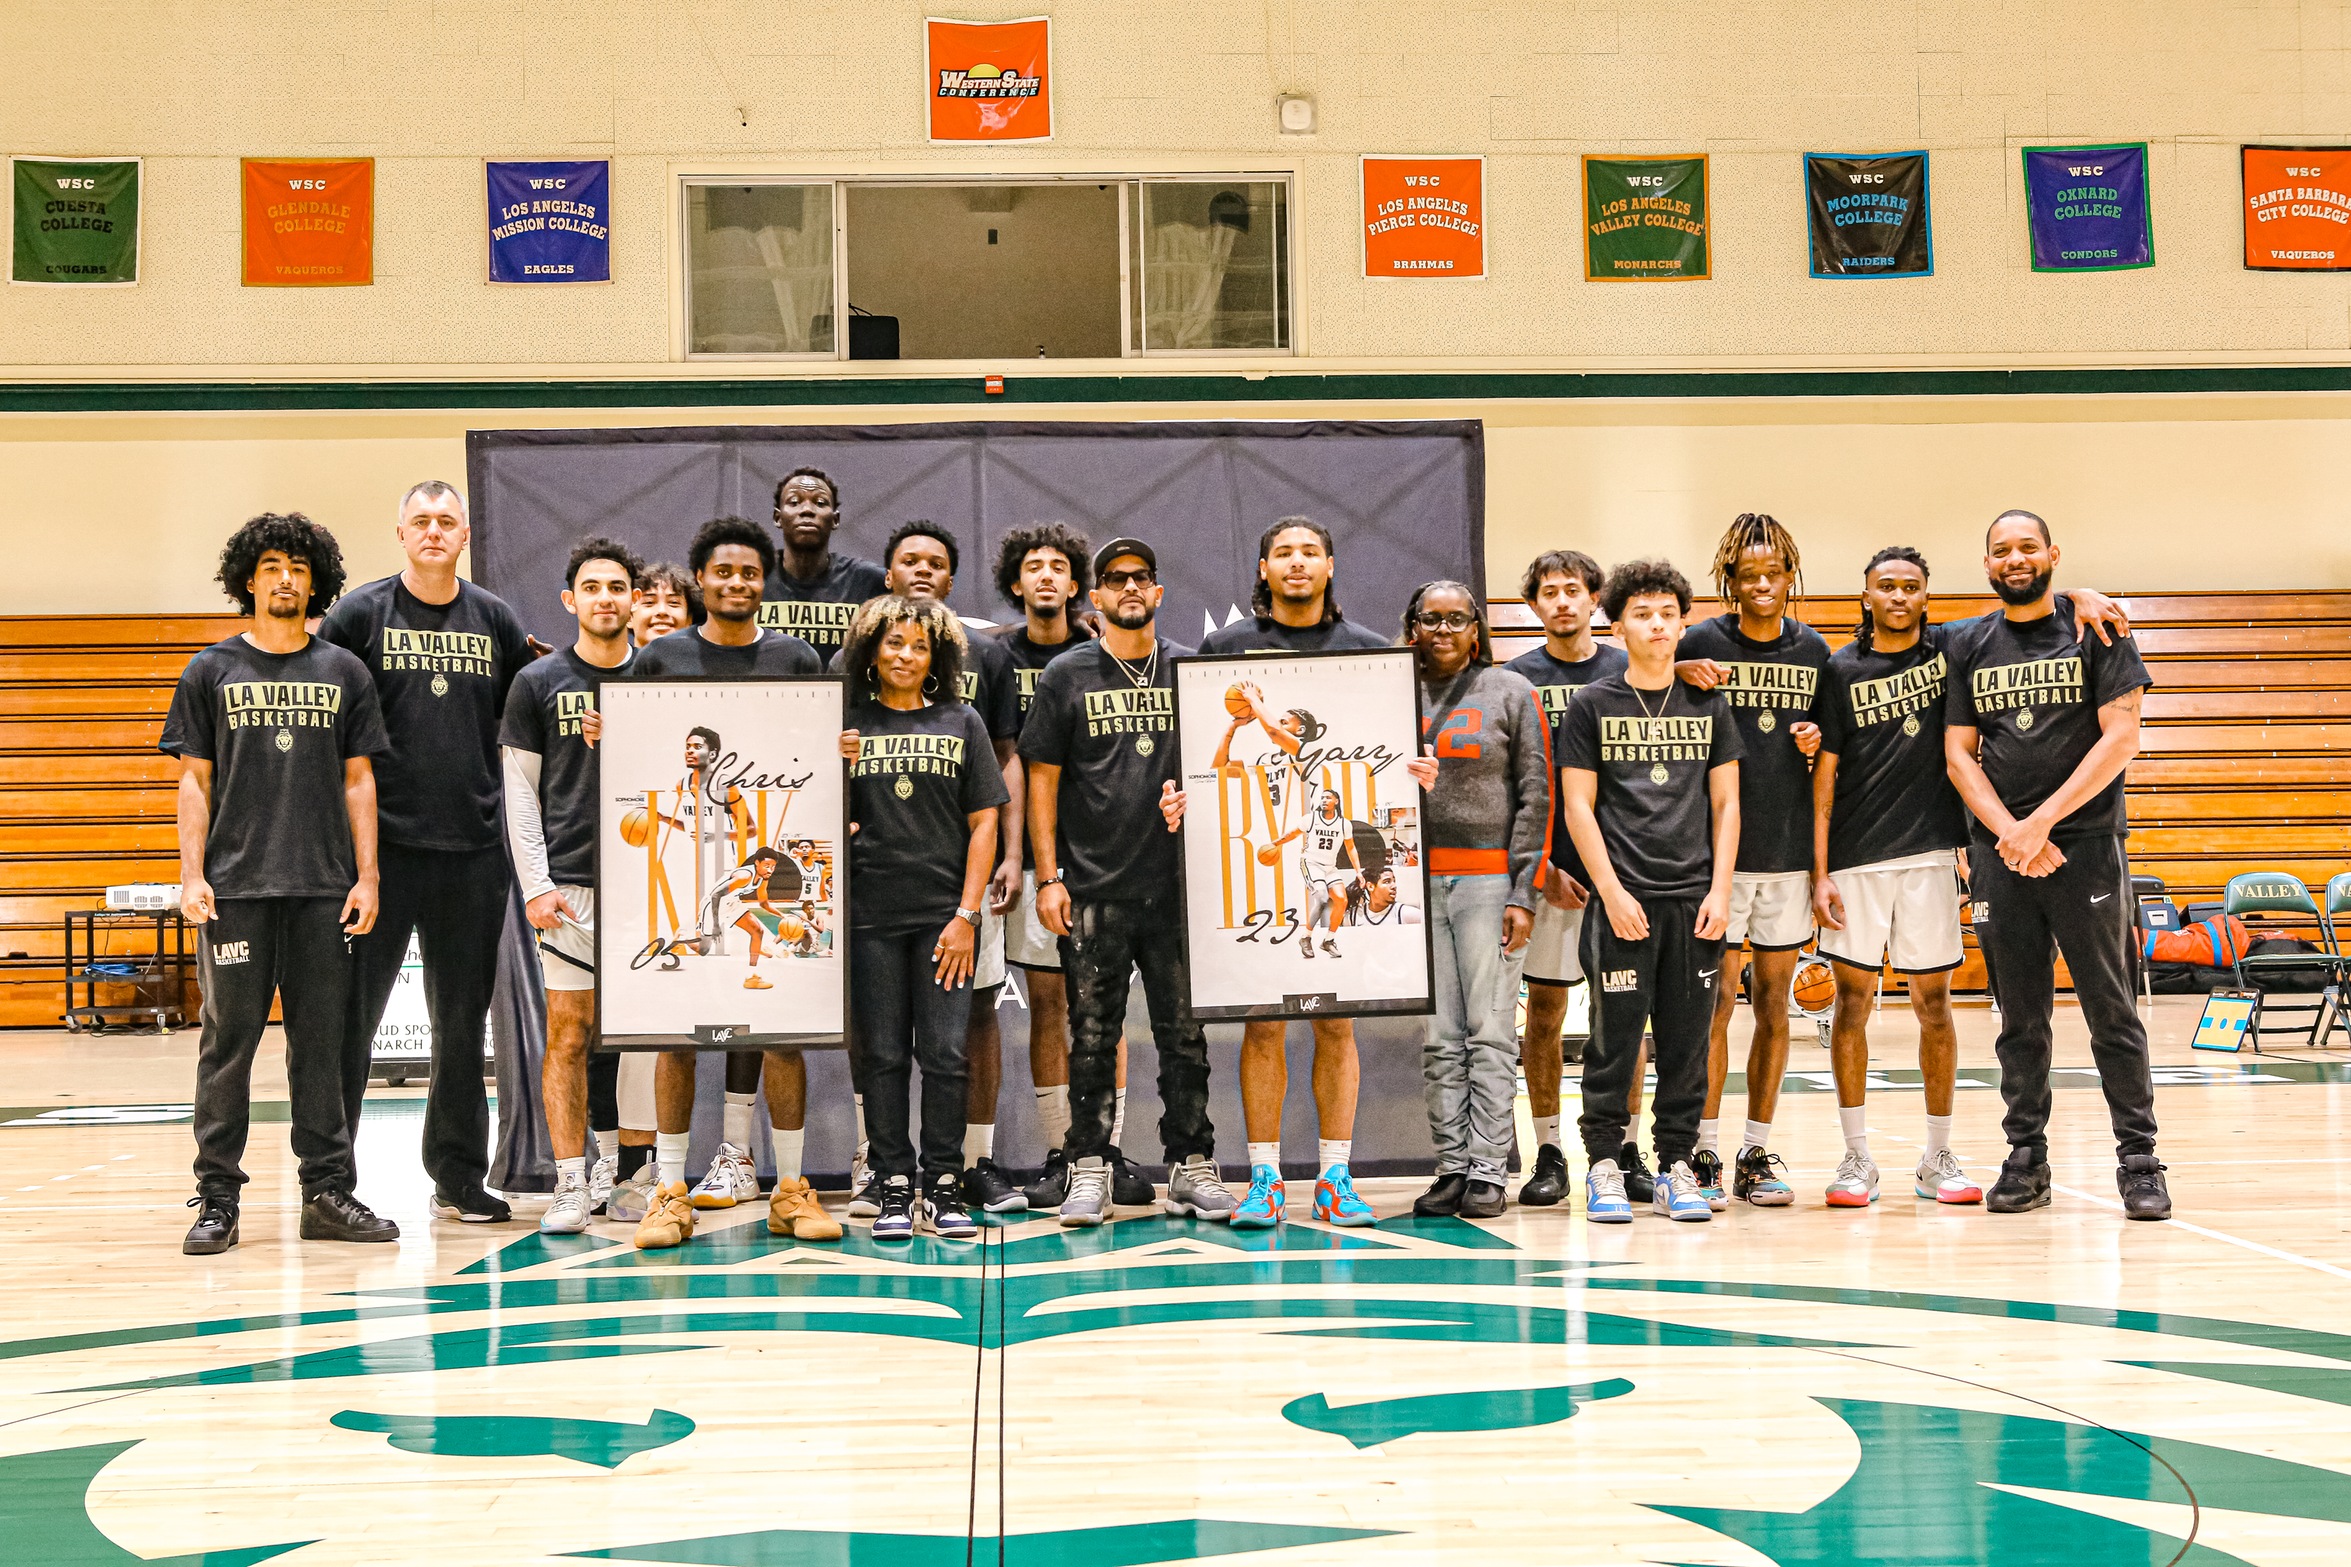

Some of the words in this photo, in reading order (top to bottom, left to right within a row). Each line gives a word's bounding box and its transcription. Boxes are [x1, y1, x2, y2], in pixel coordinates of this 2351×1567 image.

[1001, 71, 1040, 88] STATE
[939, 88, 1038, 97] CONFERENCE
[1849, 174, 1884, 184] WSC
[2068, 166, 2104, 177] WSC
[2285, 167, 2321, 177] WSC
[57, 179, 95, 189] WSC
[289, 180, 326, 190] WSC
[530, 179, 566, 189] WSC
[1404, 176, 1440, 187] WSC
[1626, 176, 1663, 187] WSC
[2056, 187, 2118, 203] OXNARD
[2250, 188, 2294, 209] SANTA
[45, 200, 106, 215] CUESTA
[267, 202, 351, 218] GLENDALE
[502, 203, 529, 220] LOS
[532, 200, 596, 219] ANGELES
[1377, 198, 1404, 217] LOS
[1407, 197, 1469, 217] ANGELES
[1601, 199, 1628, 217] LOS
[1630, 197, 1692, 217] ANGELES
[1826, 194, 1909, 213] MOORPARK
[1834, 211, 1903, 227] COLLEGE
[2054, 204, 2123, 220] COLLEGE
[2257, 205, 2287, 222] CITY
[2291, 204, 2350, 225] COLLEGE
[41, 217, 114, 233] COLLEGE
[274, 219, 346, 234] COLLEGE
[492, 218, 545, 241] MISSION
[548, 217, 608, 240] COLLEGE
[1367, 213, 1416, 237] PIERCE
[1418, 213, 1480, 237] COLLEGE
[1590, 215, 1640, 237] VALLEY
[1643, 213, 1703, 237] COLLEGE
[1842, 257, 1895, 267] RAIDERS
[2061, 249, 2118, 260] CONDORS
[2271, 250, 2335, 260] VAQUEROS
[46, 265, 107, 274] COUGARS
[276, 266, 344, 274] VAQUEROS
[524, 265, 574, 274] EAGLES
[1393, 260, 1454, 269] BRAHMAS
[1613, 260, 1682, 269] MONARCHS
[758, 604, 779, 624] LA
[787, 604, 855, 626] VALLEY
[388, 631, 412, 651] LA
[418, 633, 487, 657] VALLEY
[382, 655, 492, 677] BASKETBALL
[1749, 666, 1815, 691] VALLEY
[1977, 671, 1999, 694] LA
[2007, 661, 2078, 688] VALLEY
[228, 685, 255, 709] LA
[262, 685, 337, 708] VALLEY
[1855, 683, 1881, 707] LA
[1974, 687, 2083, 713] BASKETBALL
[562, 694, 586, 716] LA
[1089, 694, 1116, 716] LA
[1121, 691, 1173, 712] VALL
[1088, 716, 1174, 737] BASKETB
[1606, 720, 1630, 741] LA
[885, 738, 960, 759] VALLEY
[849, 758, 957, 779] BASKETBALL
[706, 751, 814, 806] Chris
[1315, 829, 1340, 838] VALLEY
[1318, 838, 1334, 850] 23
[804, 883, 812, 895] 5
[2233, 884, 2302, 898] VALLEY
[1236, 908, 1299, 945] 23
[213, 940, 250, 959] LAVC
[1601, 969, 1637, 986] LAVC
[1703, 977, 1712, 988] 6
[1300, 996, 1320, 1012] LAVC
[712, 1027, 733, 1043] LAVC
